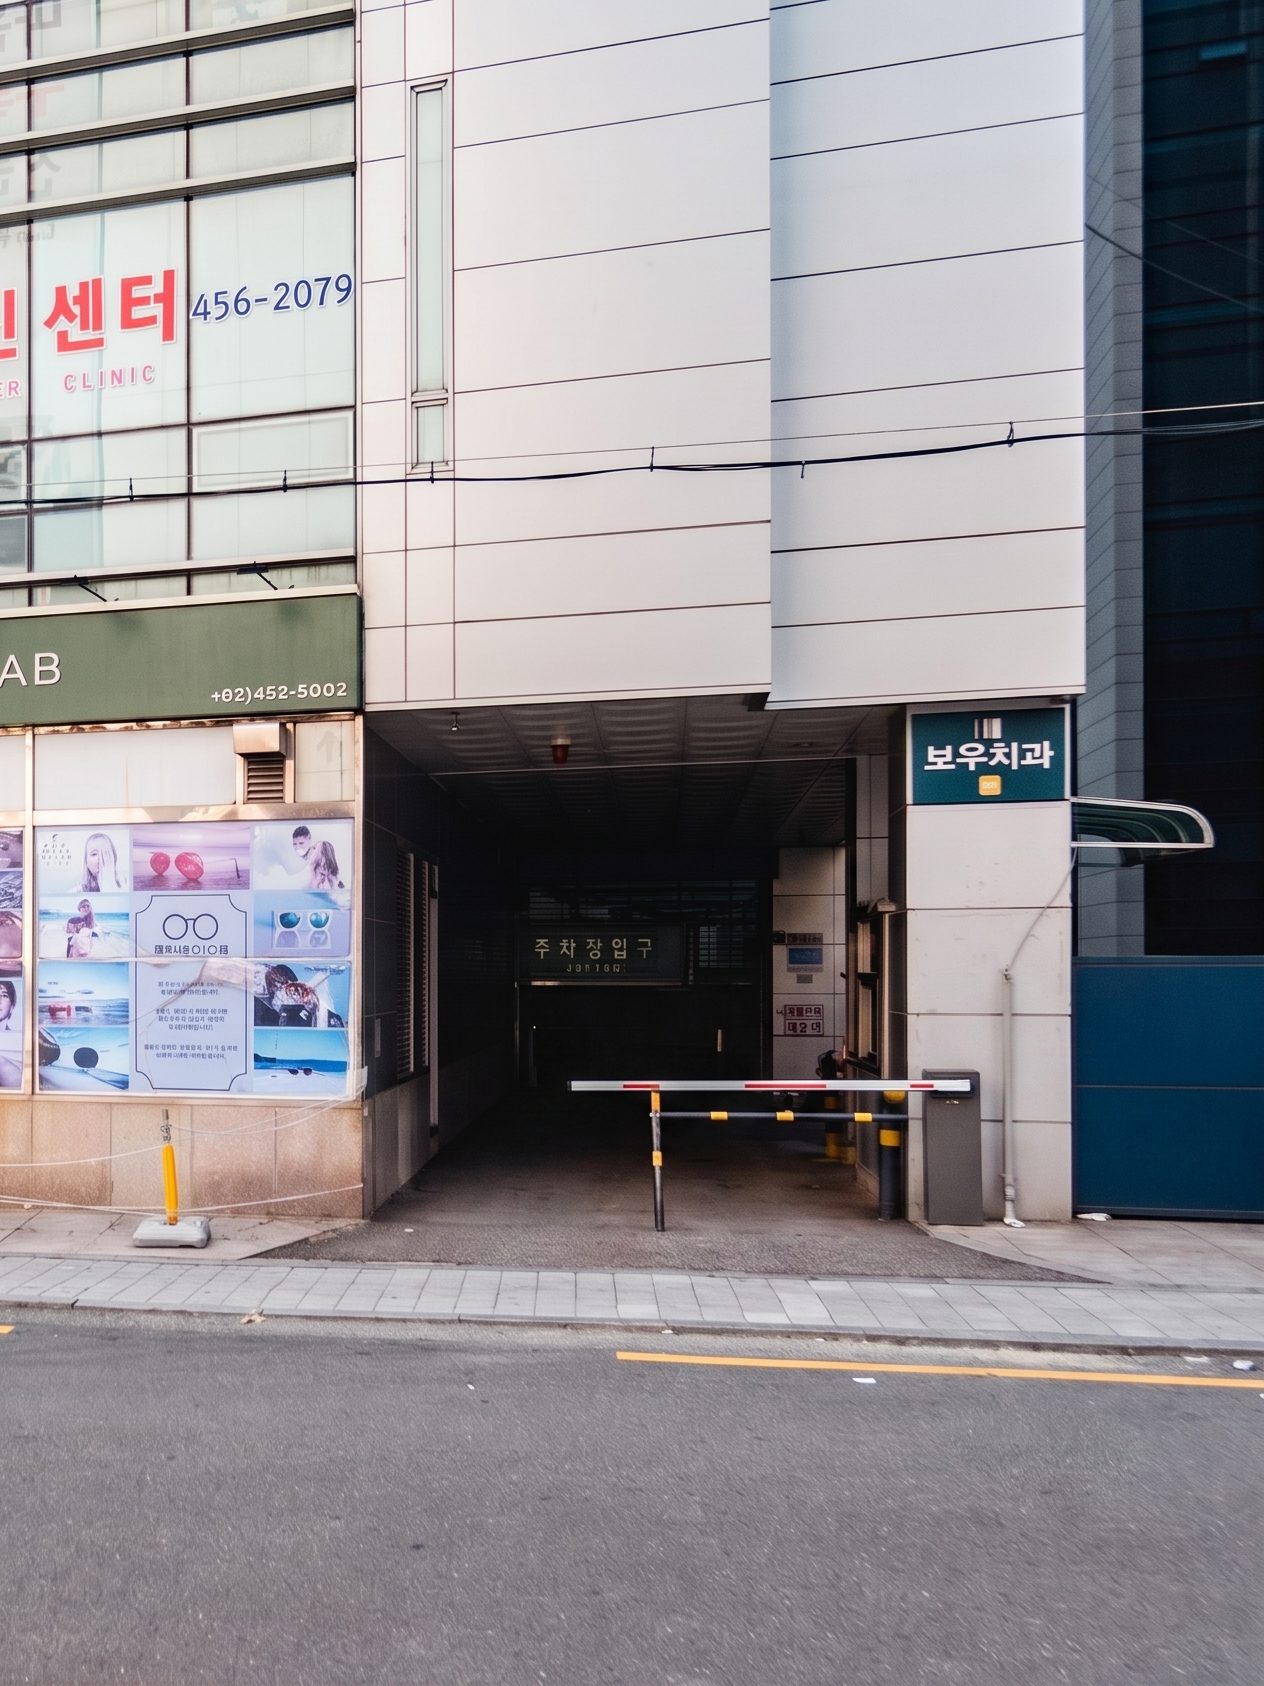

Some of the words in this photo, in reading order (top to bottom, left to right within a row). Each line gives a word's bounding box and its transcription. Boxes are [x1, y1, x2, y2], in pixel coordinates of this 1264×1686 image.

[44, 269, 177, 353] 센터
[192, 273, 354, 322] 456-2079
[64, 365, 155, 393] CLINIC
[924, 740, 1055, 772] 보우치과
